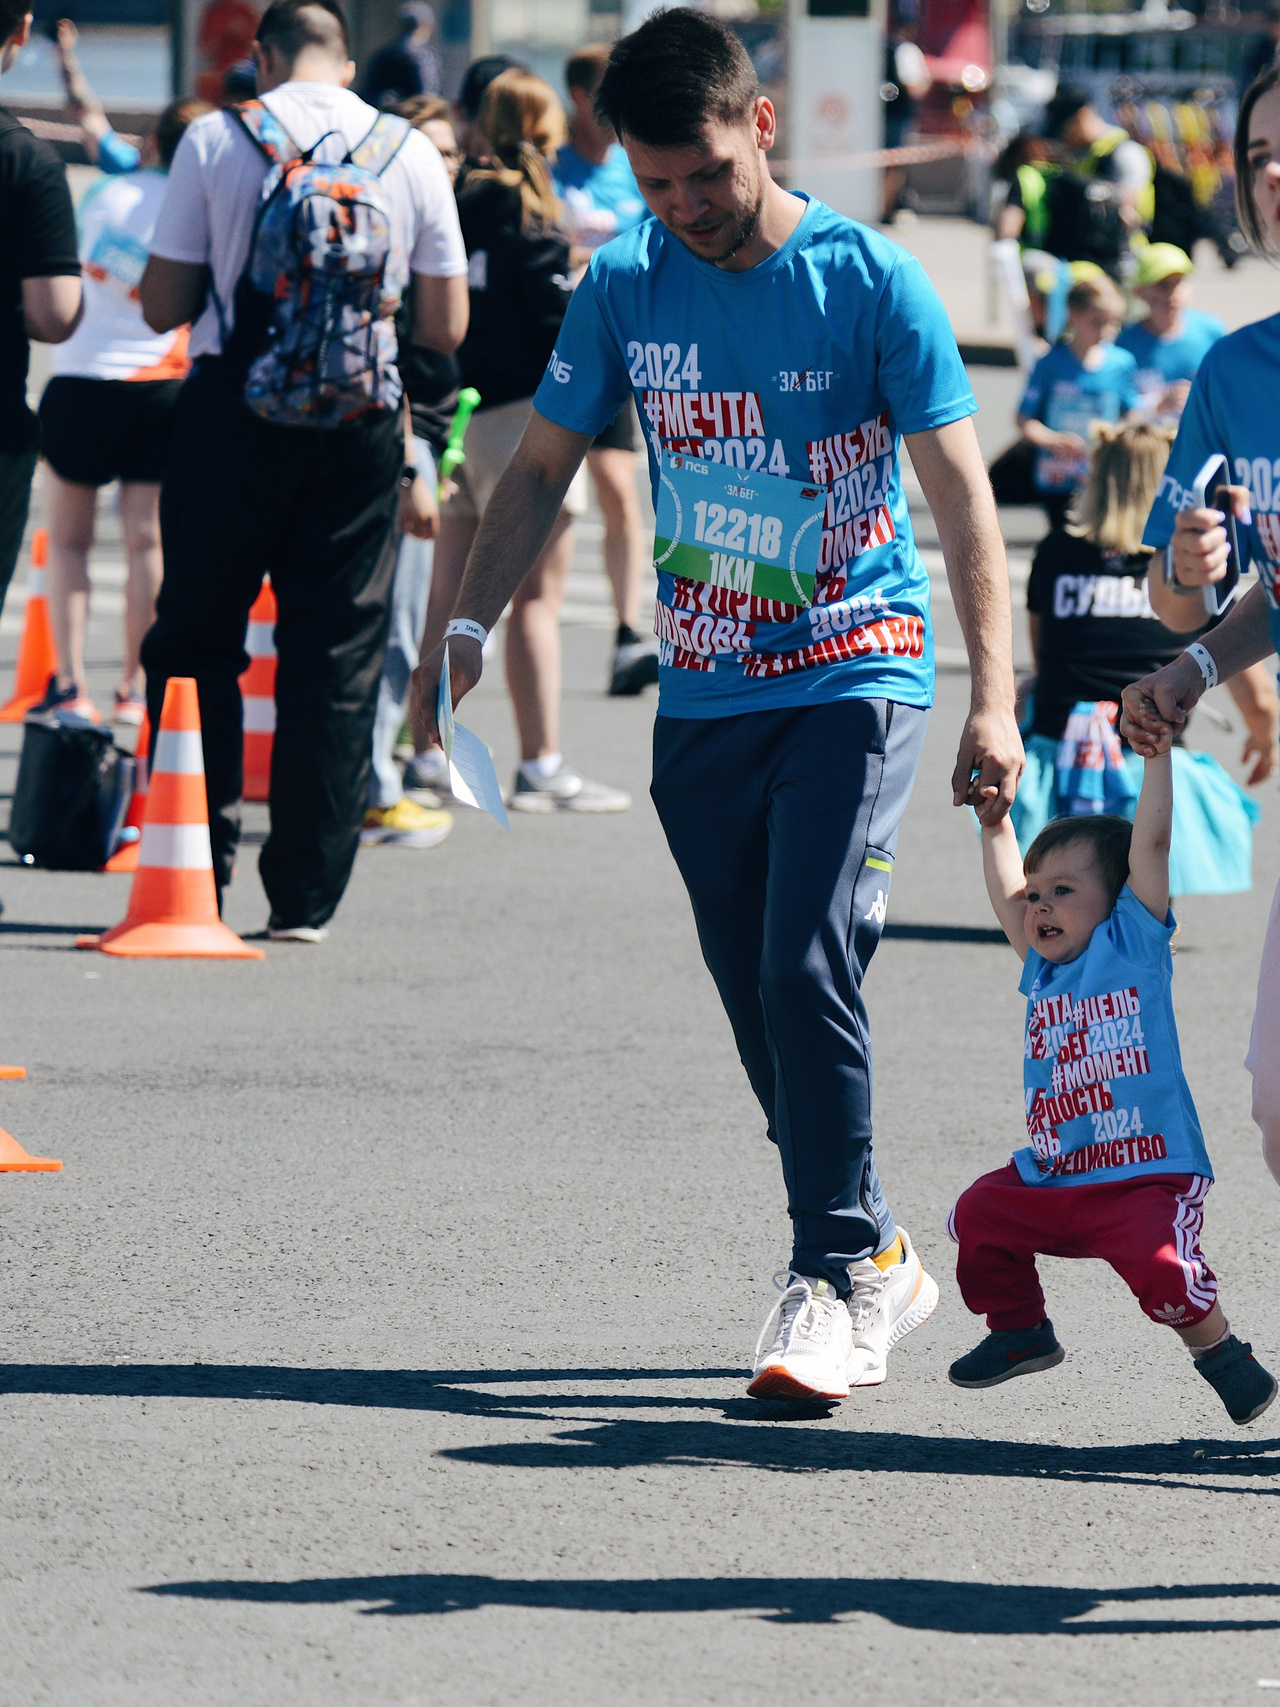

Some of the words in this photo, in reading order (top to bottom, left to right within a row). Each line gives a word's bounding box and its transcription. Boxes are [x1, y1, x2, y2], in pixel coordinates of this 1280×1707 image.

[627, 340, 702, 390] 2024
[643, 390, 766, 438] #МЕЧТА
[685, 460, 709, 475] ПСБ
[808, 413, 894, 485] #ЦЕЛЬ
[693, 499, 783, 560] 12218
[1073, 987, 1141, 1031] #ЦЕЛЬ
[1051, 1045, 1147, 1095] #МОМЕНТ
[1090, 1106, 1144, 1143] 2024
